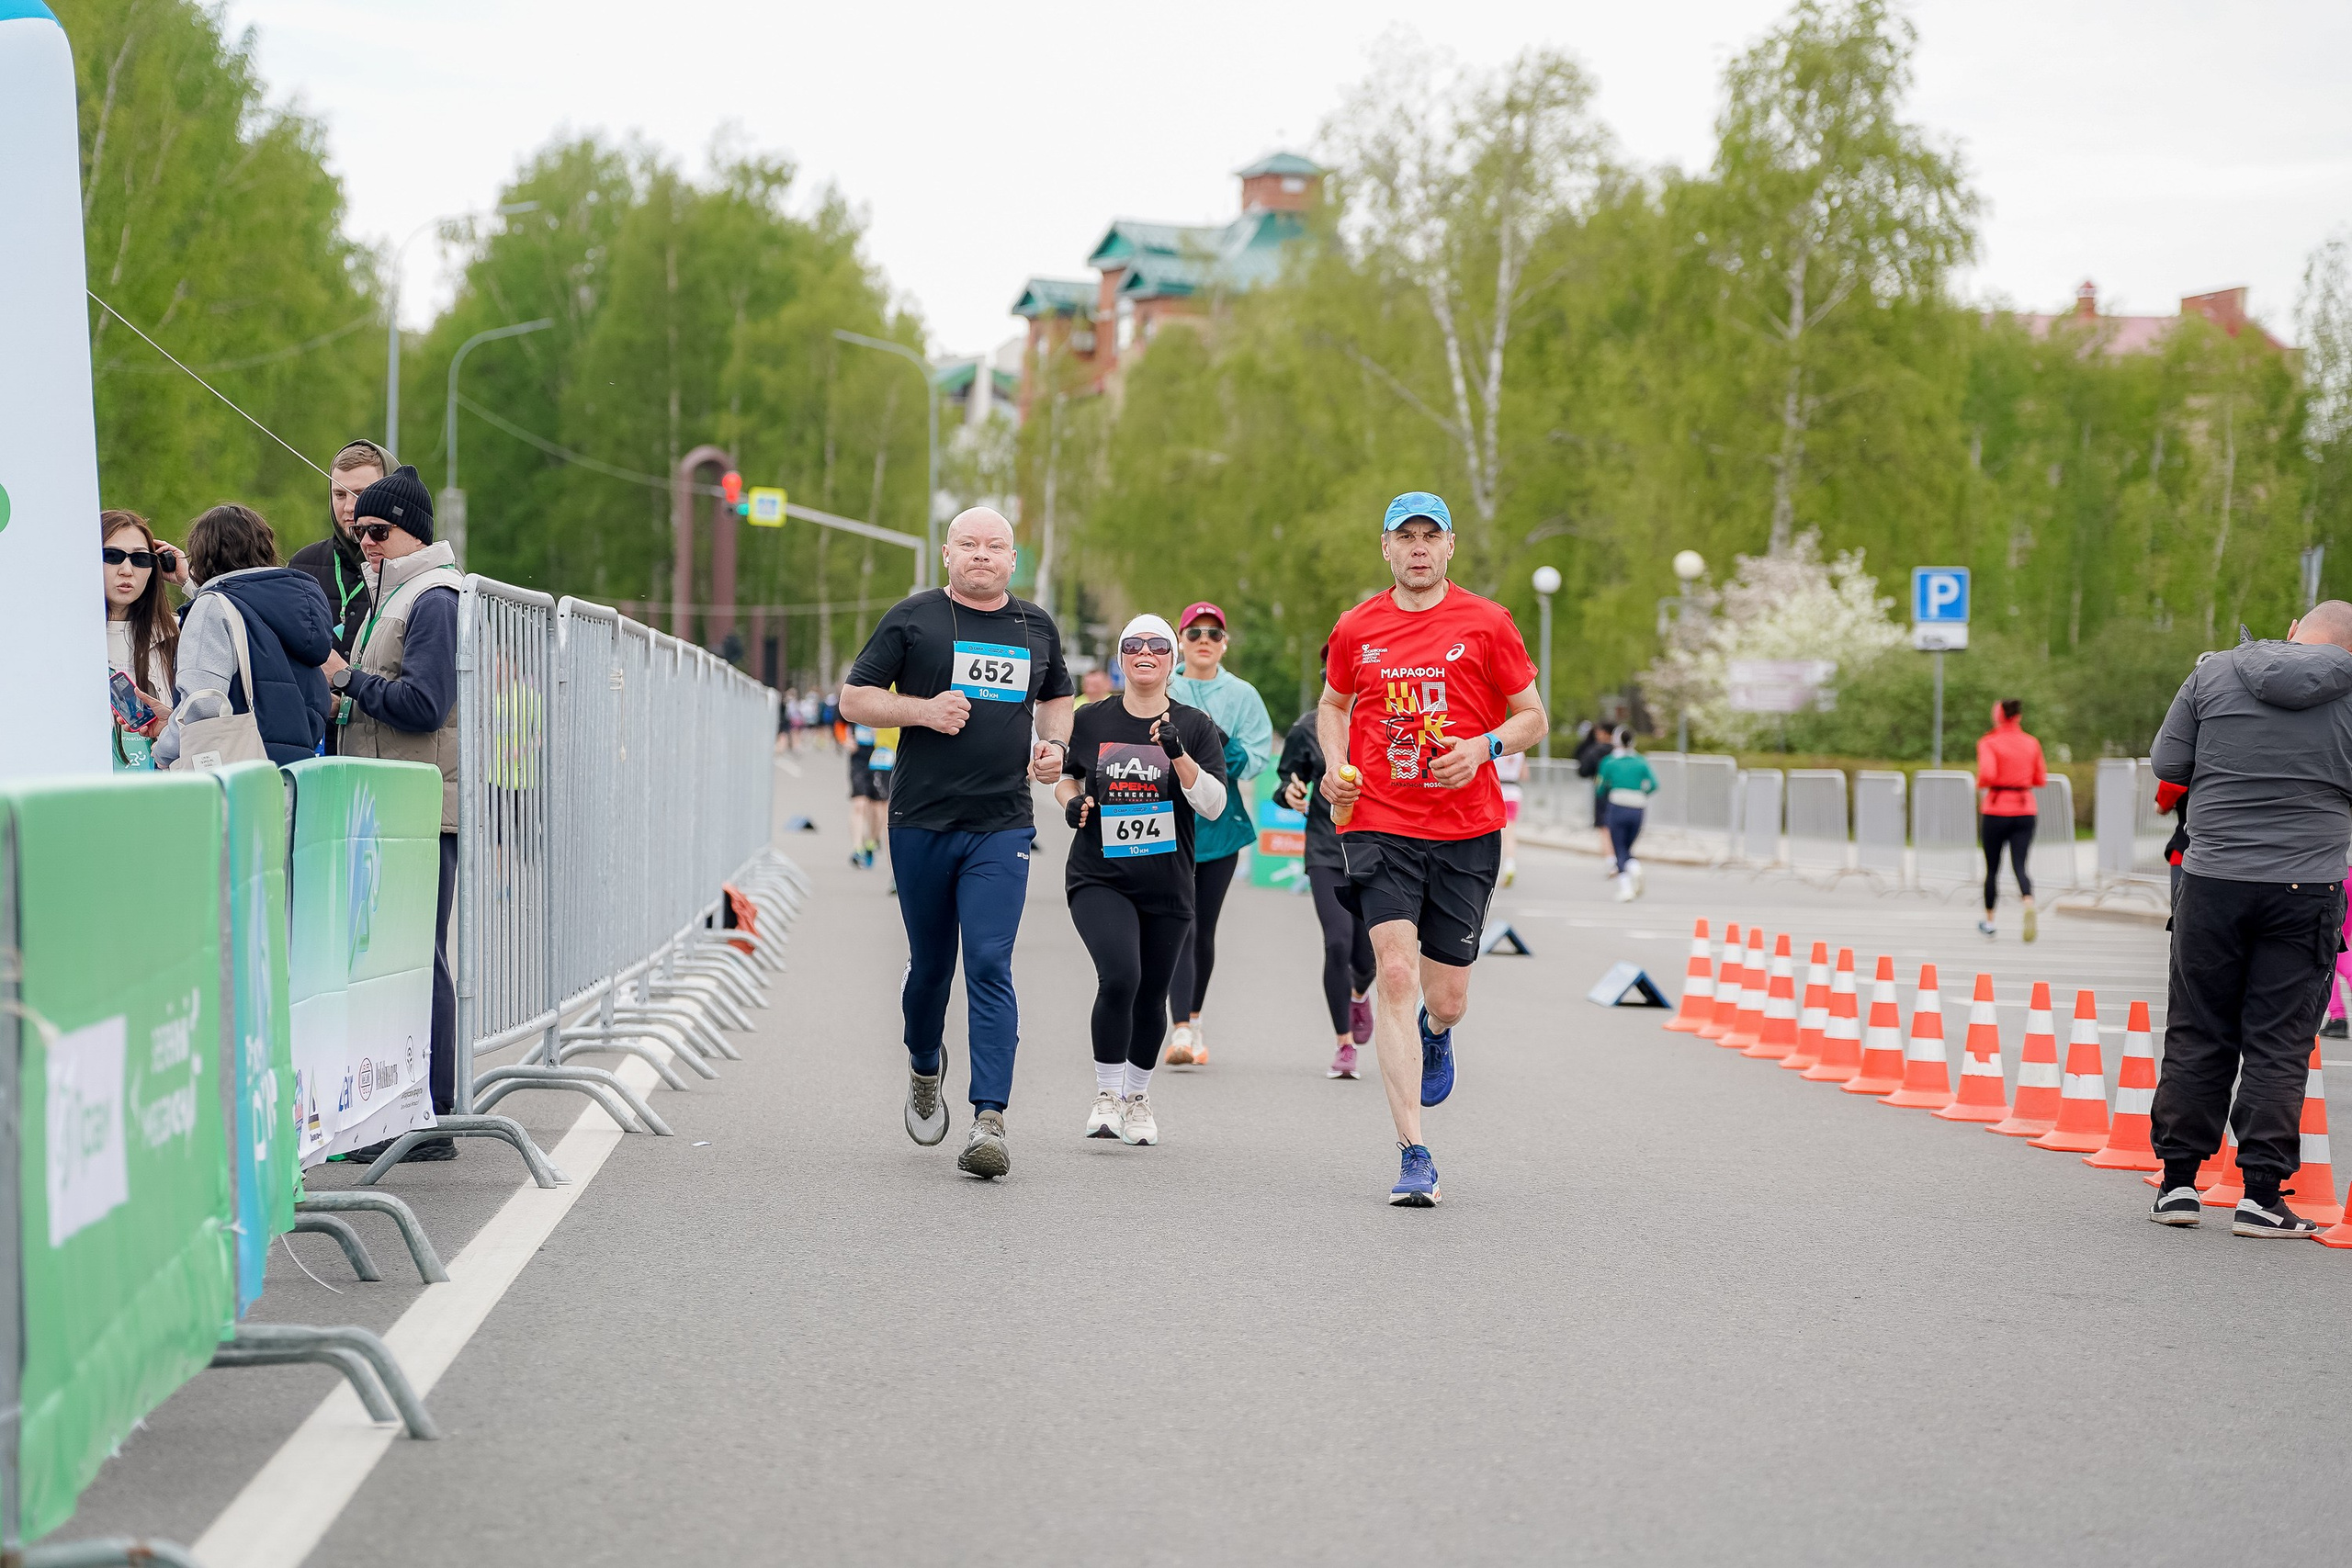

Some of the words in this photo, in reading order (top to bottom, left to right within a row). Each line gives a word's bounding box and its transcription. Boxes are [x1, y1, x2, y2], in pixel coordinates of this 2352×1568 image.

[1928, 575, 1960, 618] P
[968, 659, 1014, 684] 652
[1381, 667, 1445, 679] МАРАФОН
[1109, 781, 1159, 793] АРЕНА
[1116, 818, 1160, 840] 694
